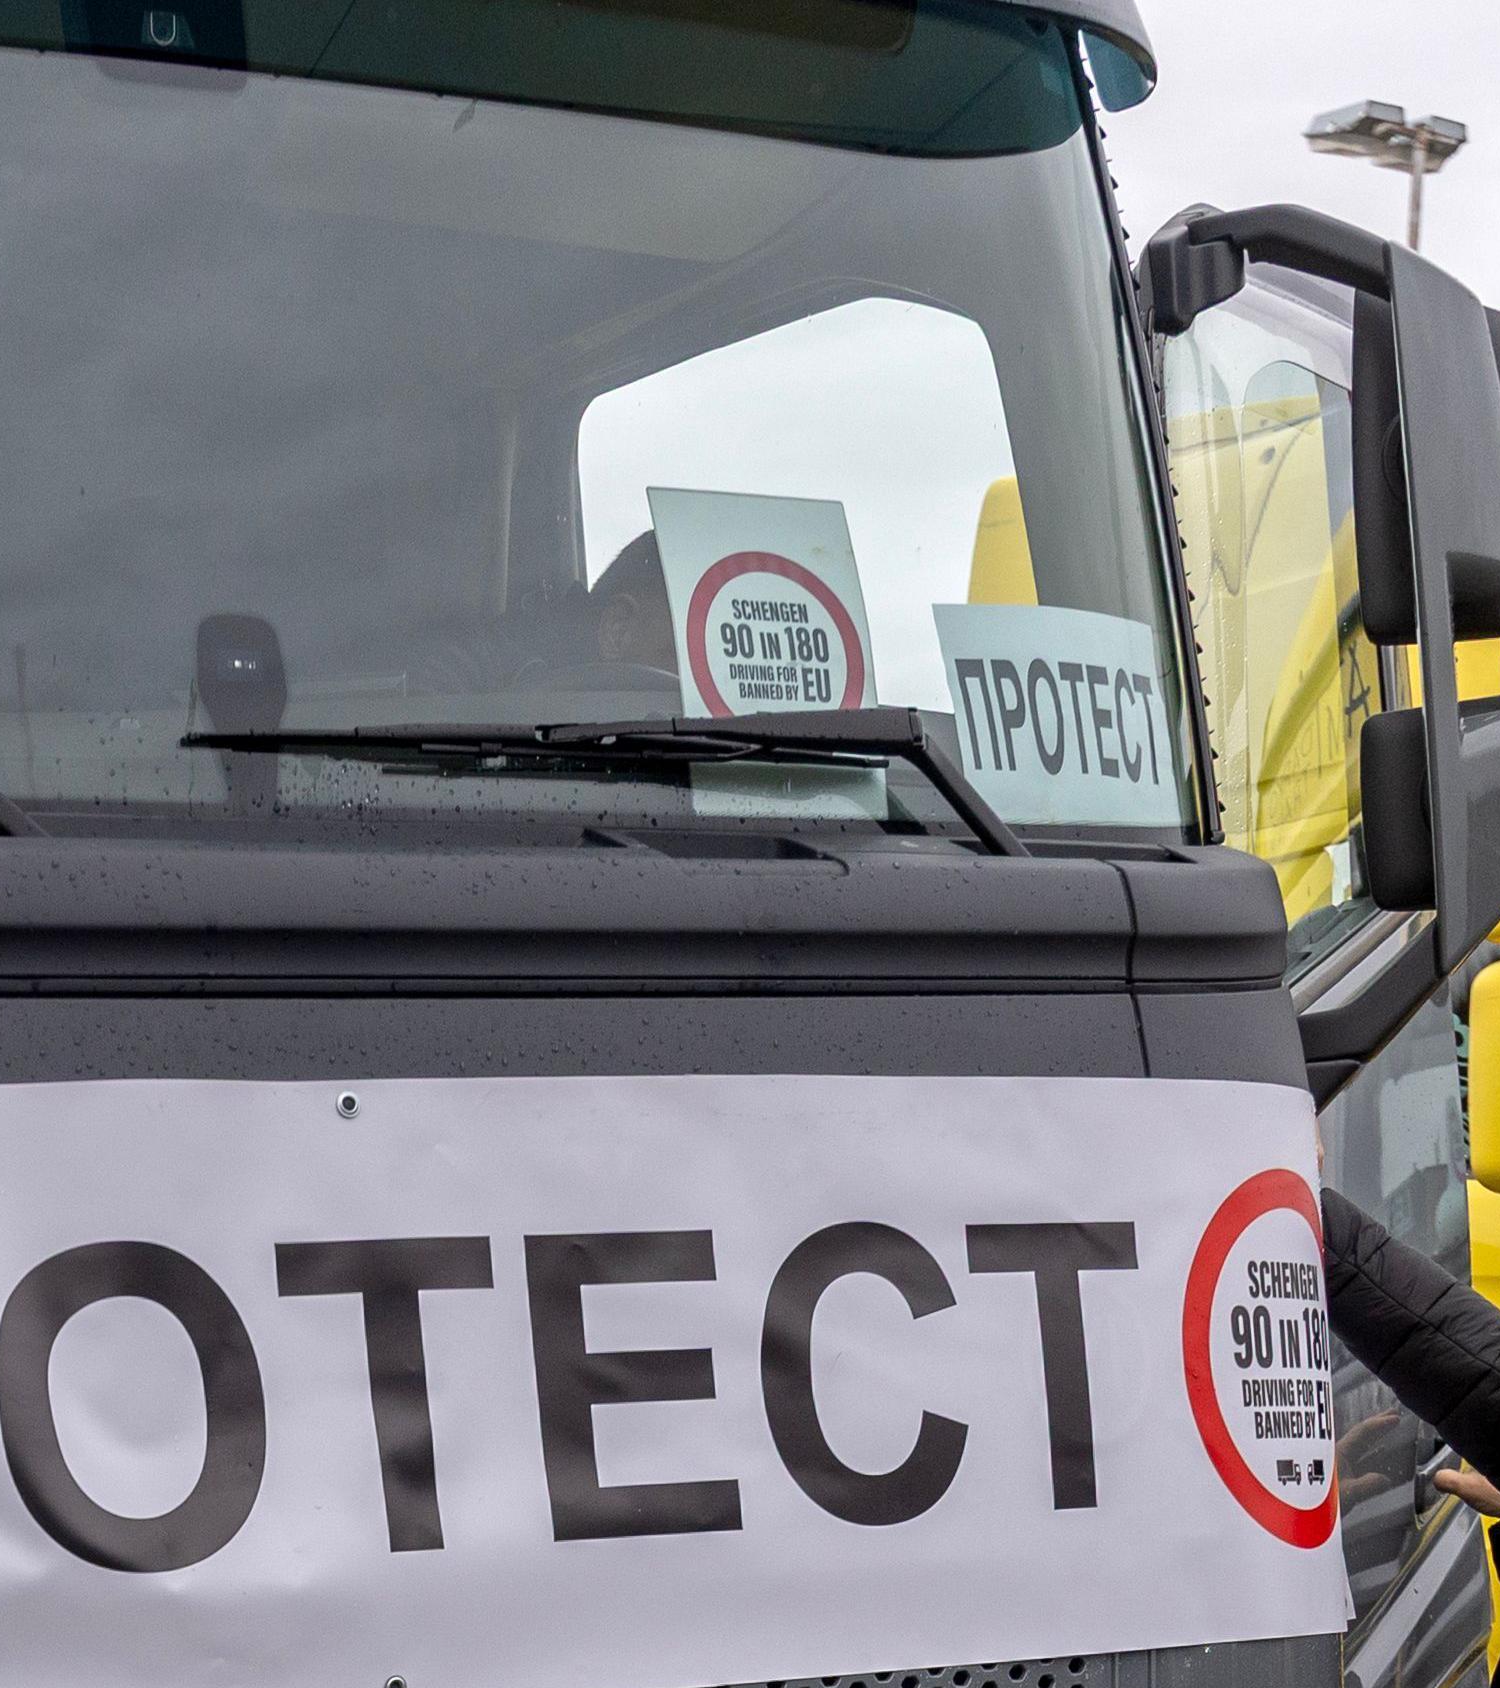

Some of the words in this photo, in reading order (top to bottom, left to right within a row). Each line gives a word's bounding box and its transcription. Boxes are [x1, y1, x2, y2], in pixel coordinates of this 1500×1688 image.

[731, 599, 809, 624] SCHENGEN
[720, 622, 755, 659] 90
[759, 632, 782, 660] IN
[784, 626, 830, 663] 180
[729, 663, 775, 682] DRIVING
[776, 666, 798, 683] FOR
[801, 667, 832, 703] EU
[739, 682, 783, 700] BANNED
[785, 684, 799, 701] BY
[955, 658, 1159, 785] ПРОТЕСТ
[1247, 1260, 1320, 1302] SCHENGEN
[1231, 1305, 1273, 1369] 90
[1279, 1319, 1301, 1369] IN
[1302, 1307, 1329, 1372] 180
[1242, 1379, 1295, 1408] DRIVING
[1297, 1379, 1315, 1408] FOR
[1316, 1380, 1332, 1441] EU
[1254, 1411, 1303, 1440] BANNED
[1304, 1411, 1316, 1440] BY
